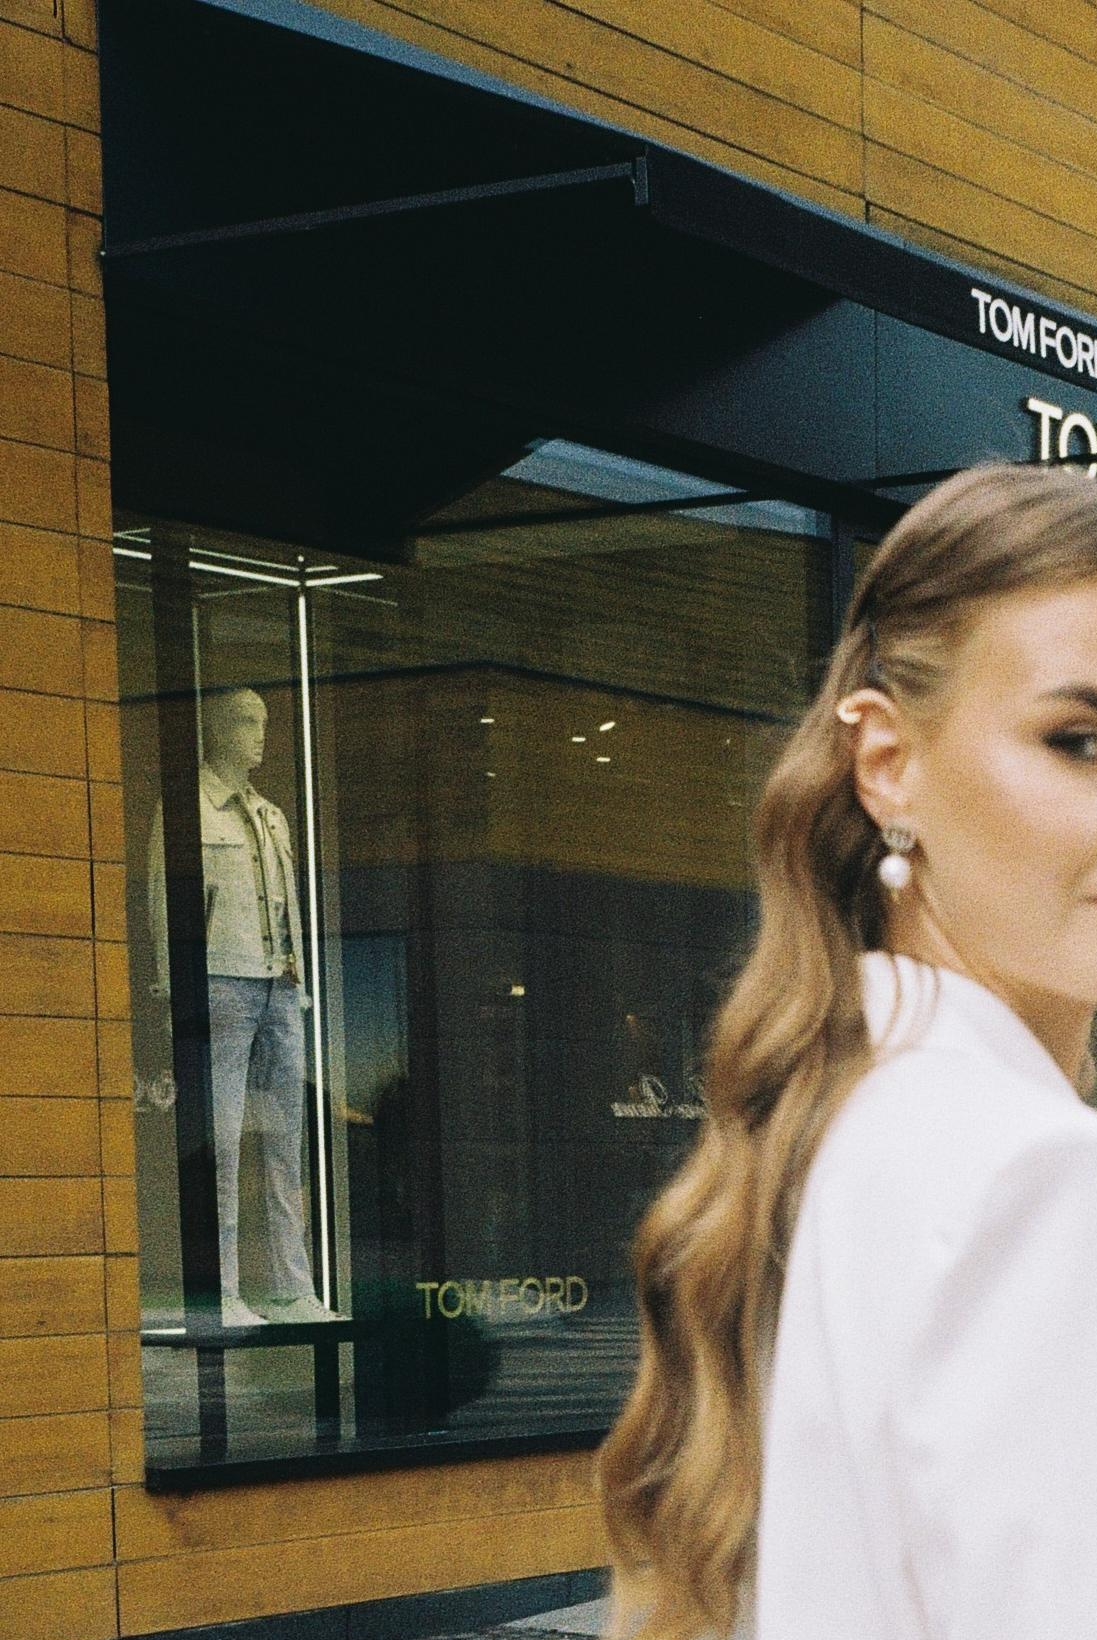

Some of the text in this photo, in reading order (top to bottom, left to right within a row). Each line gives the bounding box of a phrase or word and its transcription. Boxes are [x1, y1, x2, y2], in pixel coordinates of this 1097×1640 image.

[971, 288, 1036, 354] TOM
[416, 1276, 588, 1320] TOM FORD
